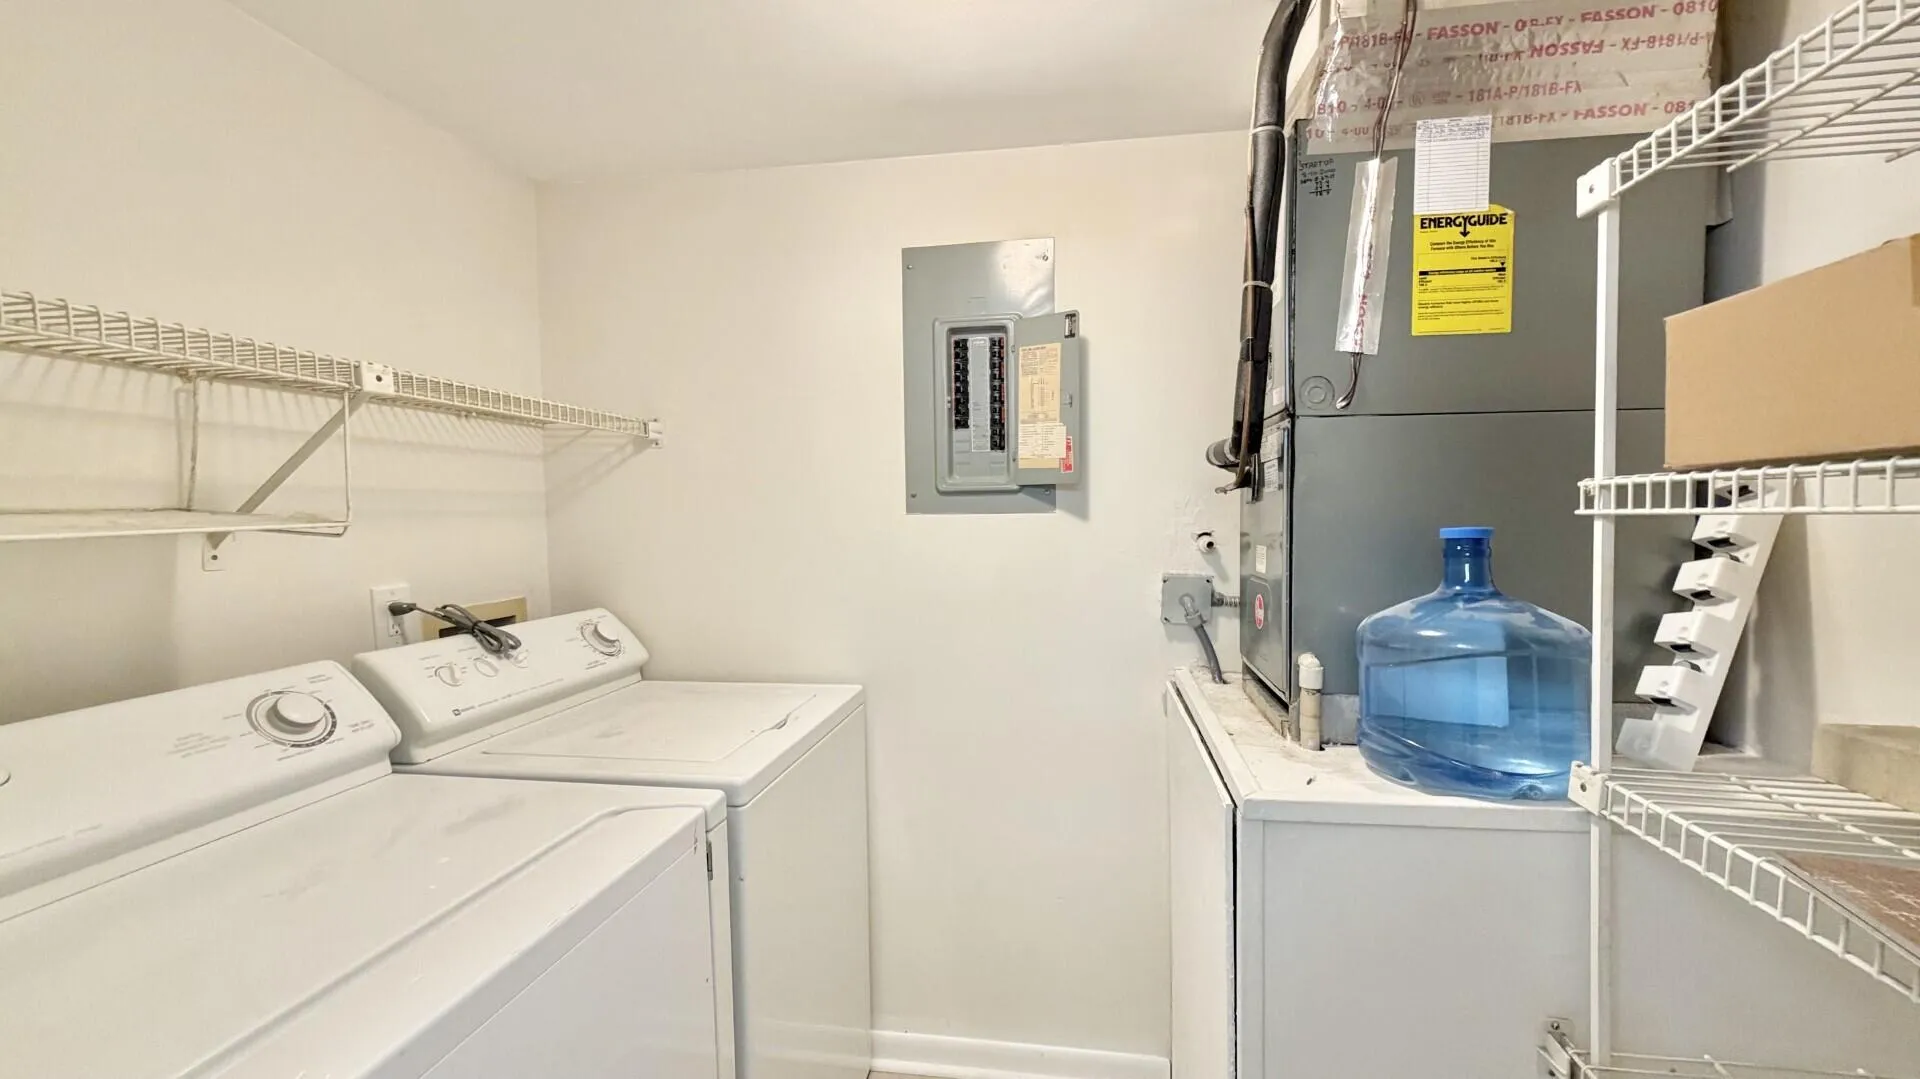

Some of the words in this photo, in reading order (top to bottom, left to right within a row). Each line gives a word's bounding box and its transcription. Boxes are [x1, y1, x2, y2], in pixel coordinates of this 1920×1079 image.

[1427, 21, 1500, 40] FASSON
[1580, 4, 1657, 23] FASSON
[1529, 39, 1604, 58] FASSON
[1420, 213, 1508, 230] ENERGYGUIDE
